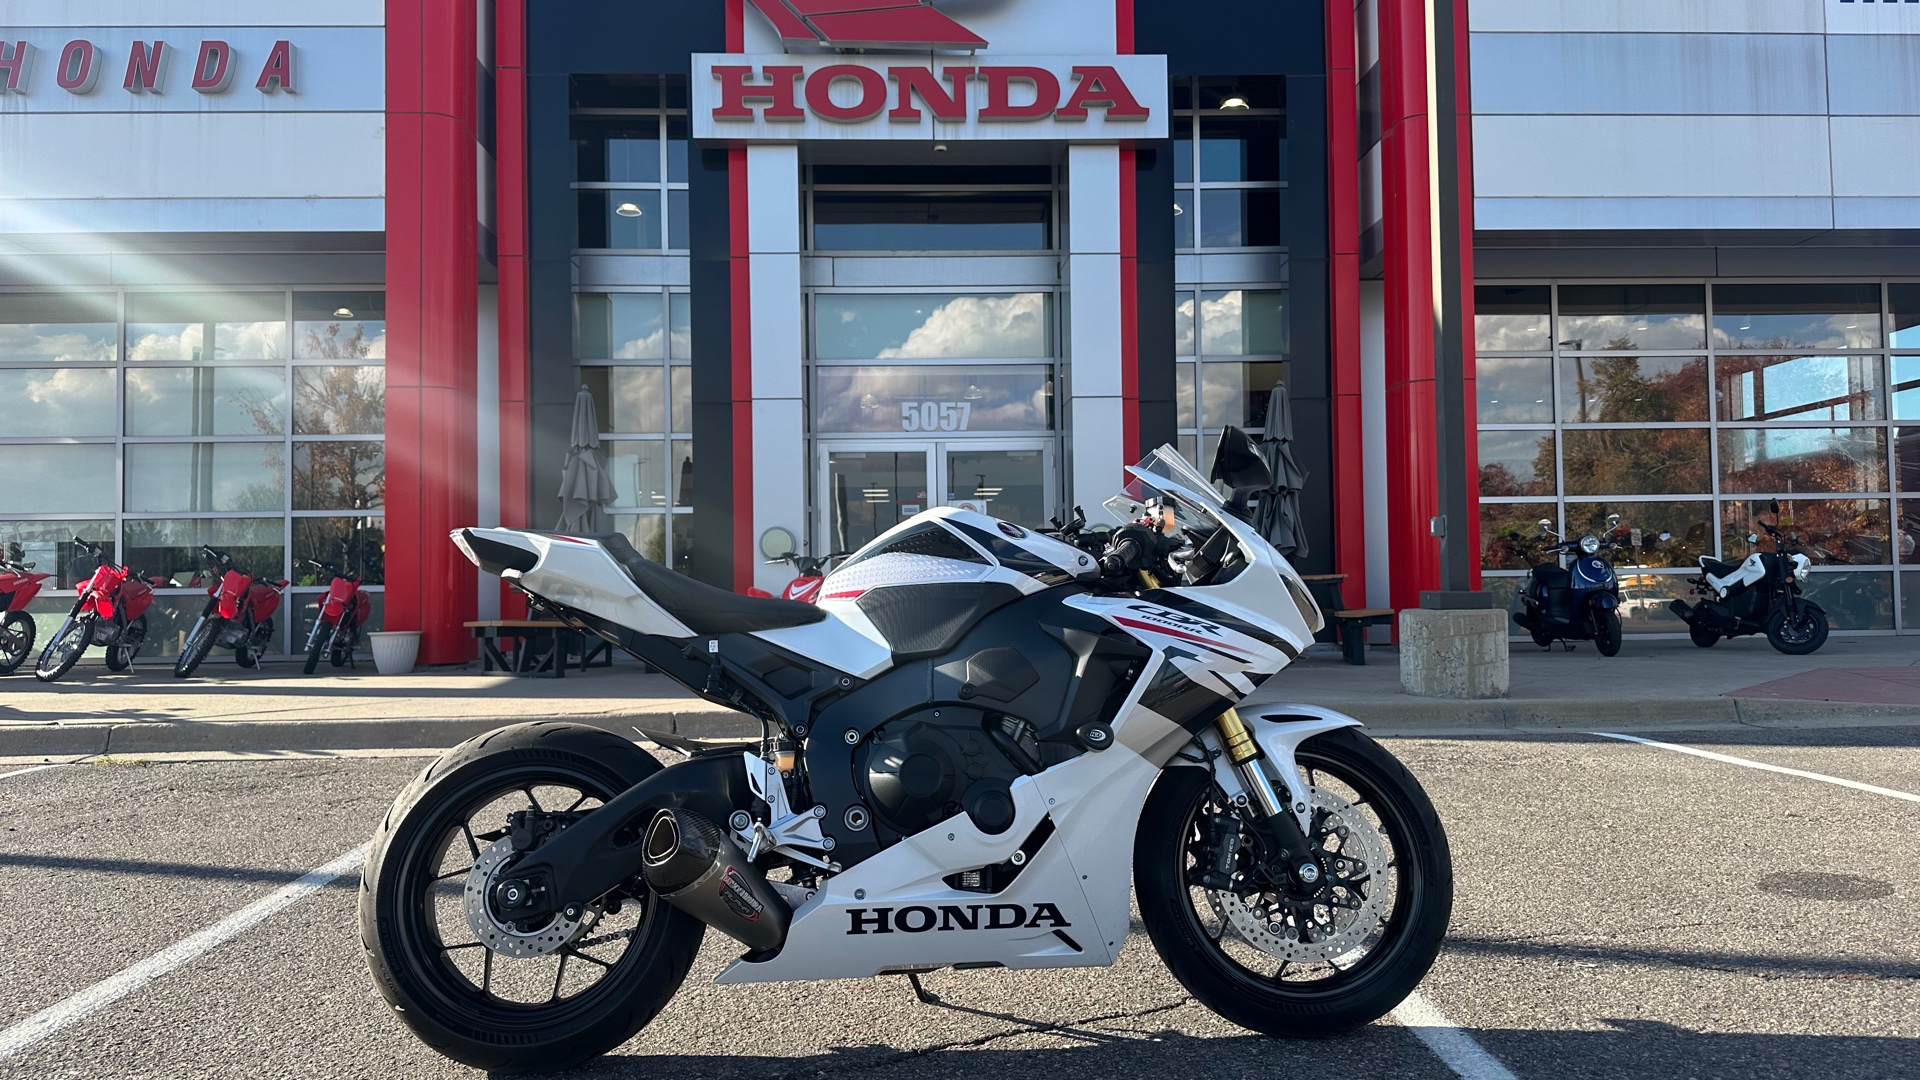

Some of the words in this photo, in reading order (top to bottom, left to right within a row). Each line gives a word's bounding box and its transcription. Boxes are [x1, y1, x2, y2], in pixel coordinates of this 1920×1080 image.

[0, 39, 297, 94] HONDA
[711, 64, 1150, 124] HONDA
[901, 401, 971, 432] 5057
[1126, 604, 1224, 638] CBR
[1225, 838, 1235, 870] TOKICO
[846, 903, 1072, 935] HONDA
